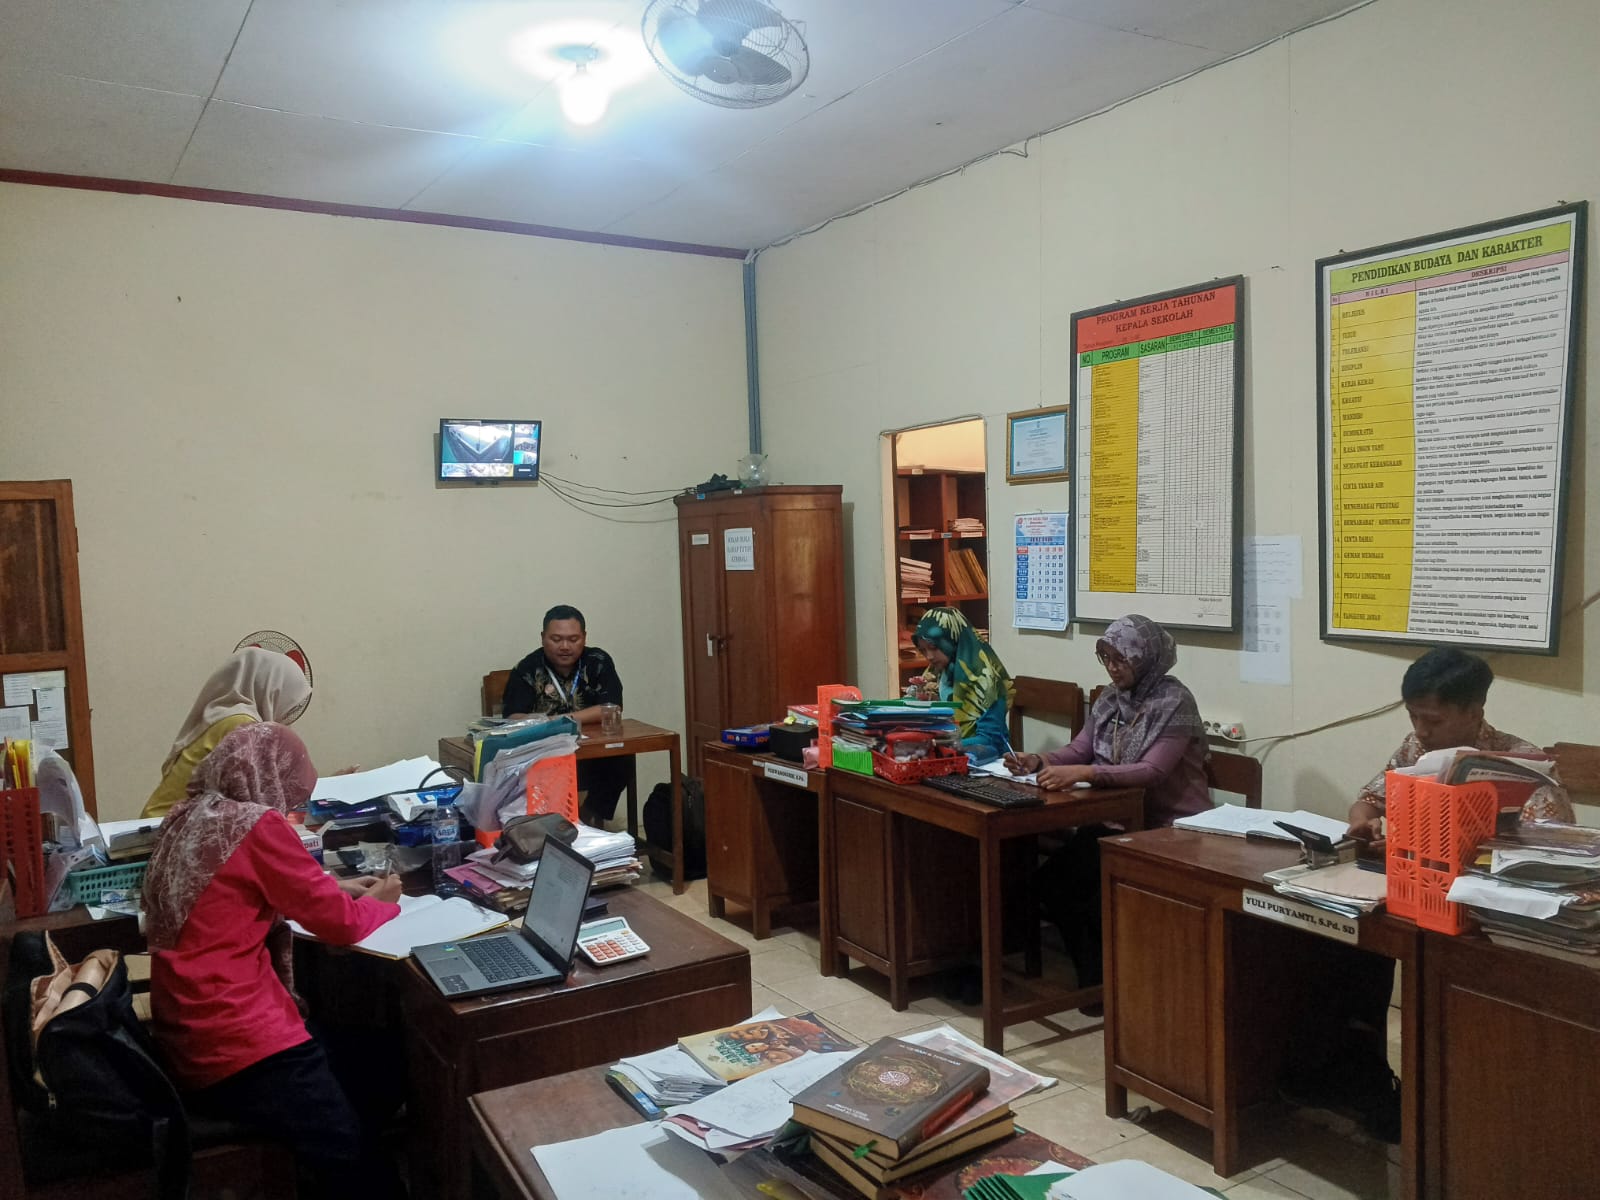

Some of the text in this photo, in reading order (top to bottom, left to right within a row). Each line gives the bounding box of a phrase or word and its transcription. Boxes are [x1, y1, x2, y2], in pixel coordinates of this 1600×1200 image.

[1351, 235, 1543, 283] PENDIDIKAN BUDAYA DAN KARAKTER
[1471, 266, 1507, 278] DESKRIPSI
[1096, 291, 1216, 325] PROGRAM KERJA TAHUNAN
[1115, 309, 1193, 334] KEPALA SEKOLAH
[1101, 346, 1130, 361] PROGRAM
[1140, 341, 1166, 354] SASARAN
[1245, 896, 1356, 935] YULI PURYANTI, S.Pd. SD
